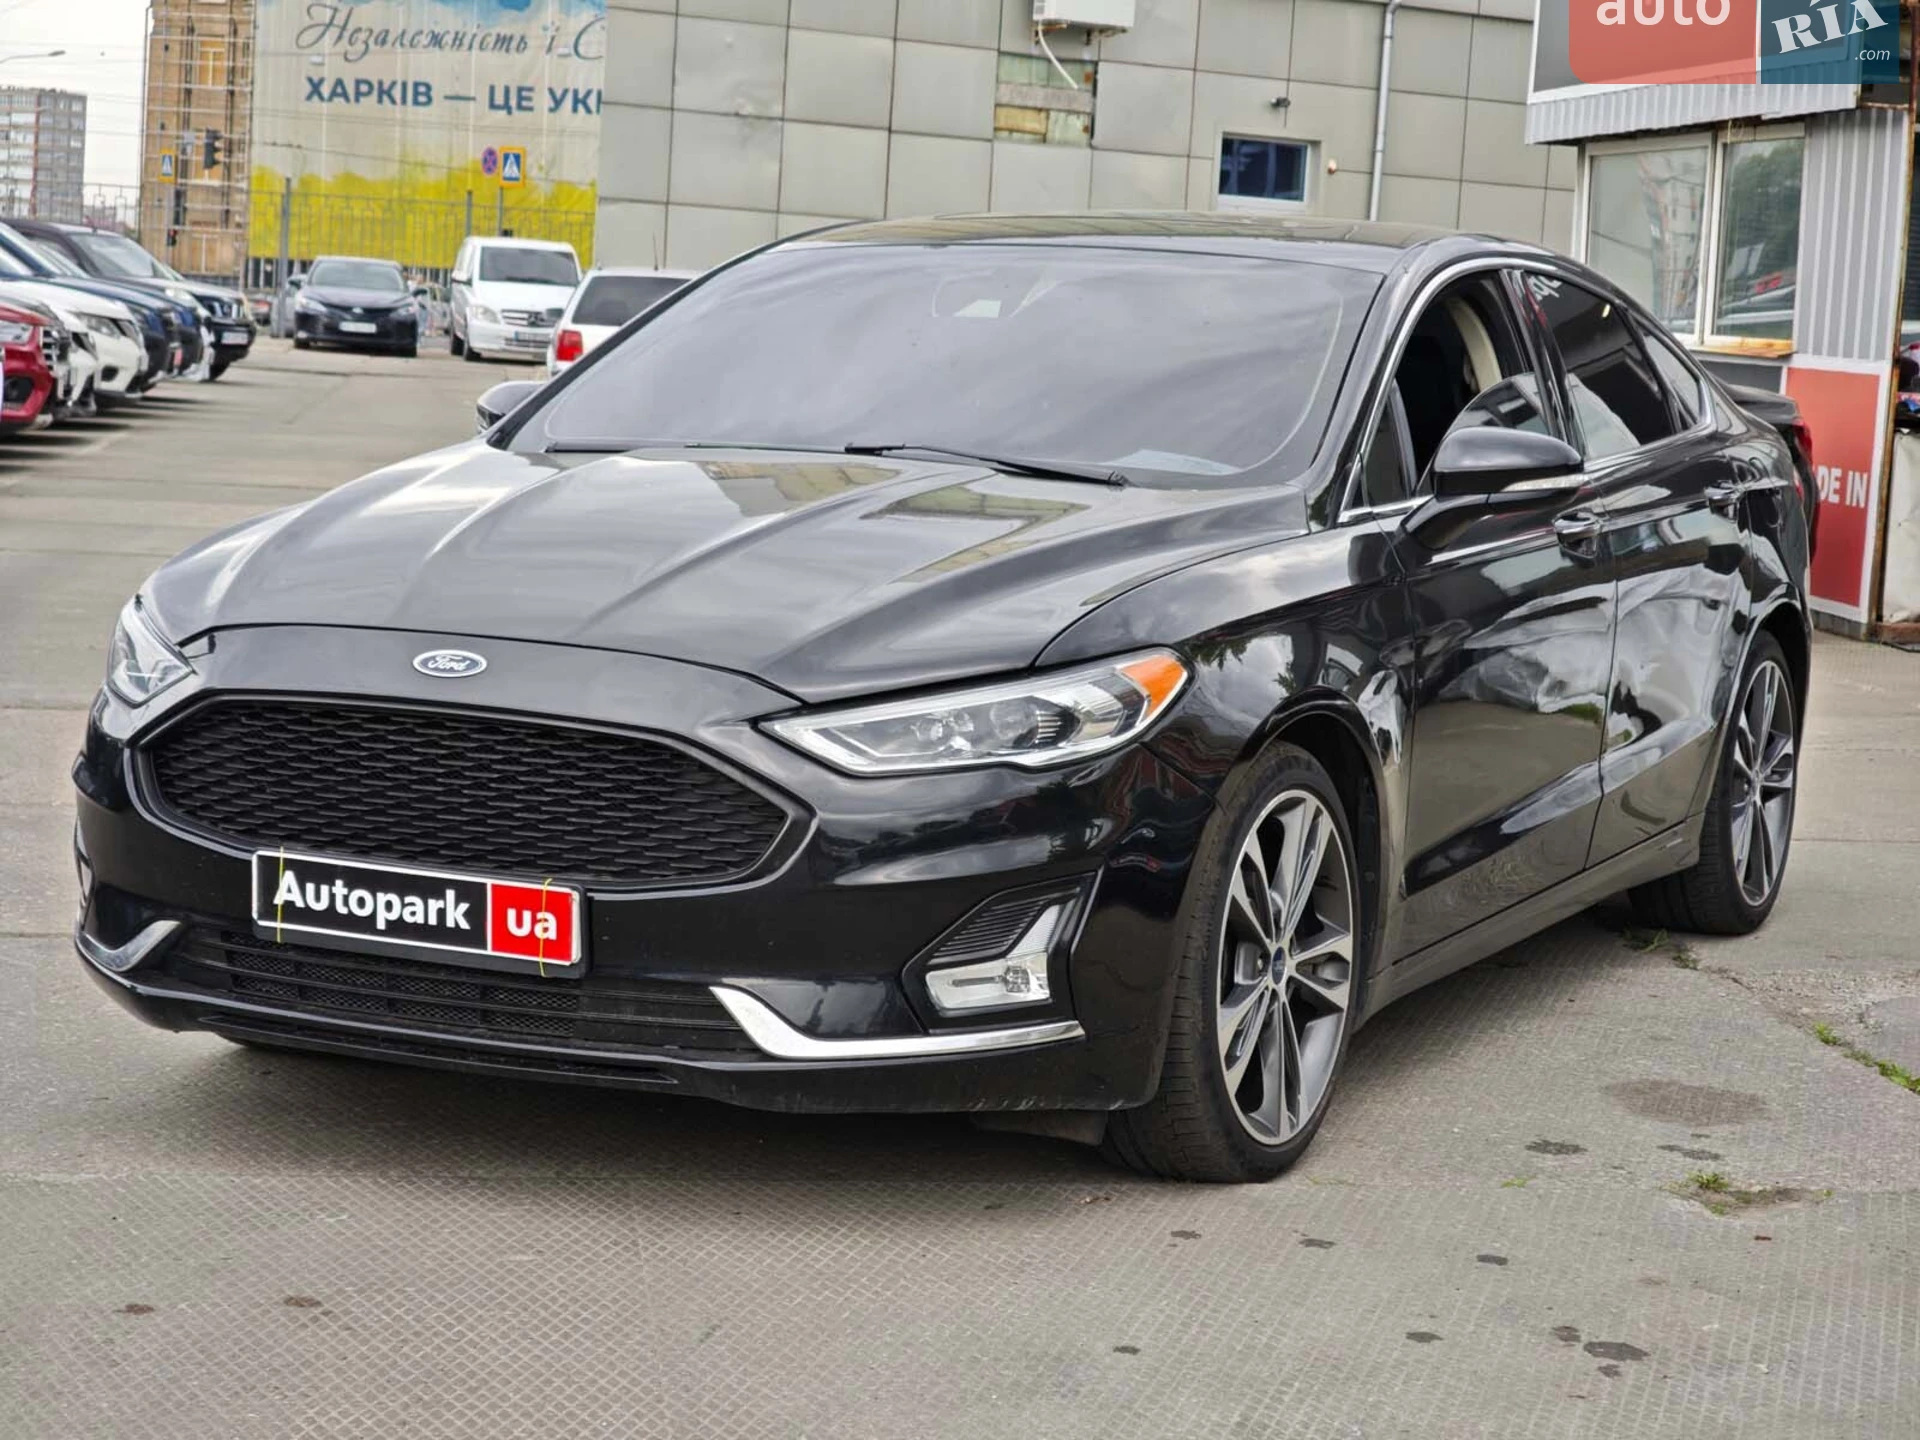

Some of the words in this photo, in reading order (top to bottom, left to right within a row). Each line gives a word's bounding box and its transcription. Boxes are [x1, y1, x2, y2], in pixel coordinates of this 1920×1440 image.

[296, 3, 528, 62] Незалежність
[305, 76, 433, 107] ХАРКІВ
[487, 84, 535, 115] ЦЕ
[547, 87, 602, 115] УК
[1816, 465, 1842, 504] DE
[1845, 471, 1868, 509] IN
[427, 654, 471, 671] Ford
[273, 870, 471, 930] Autopark
[505, 907, 557, 941] ua
